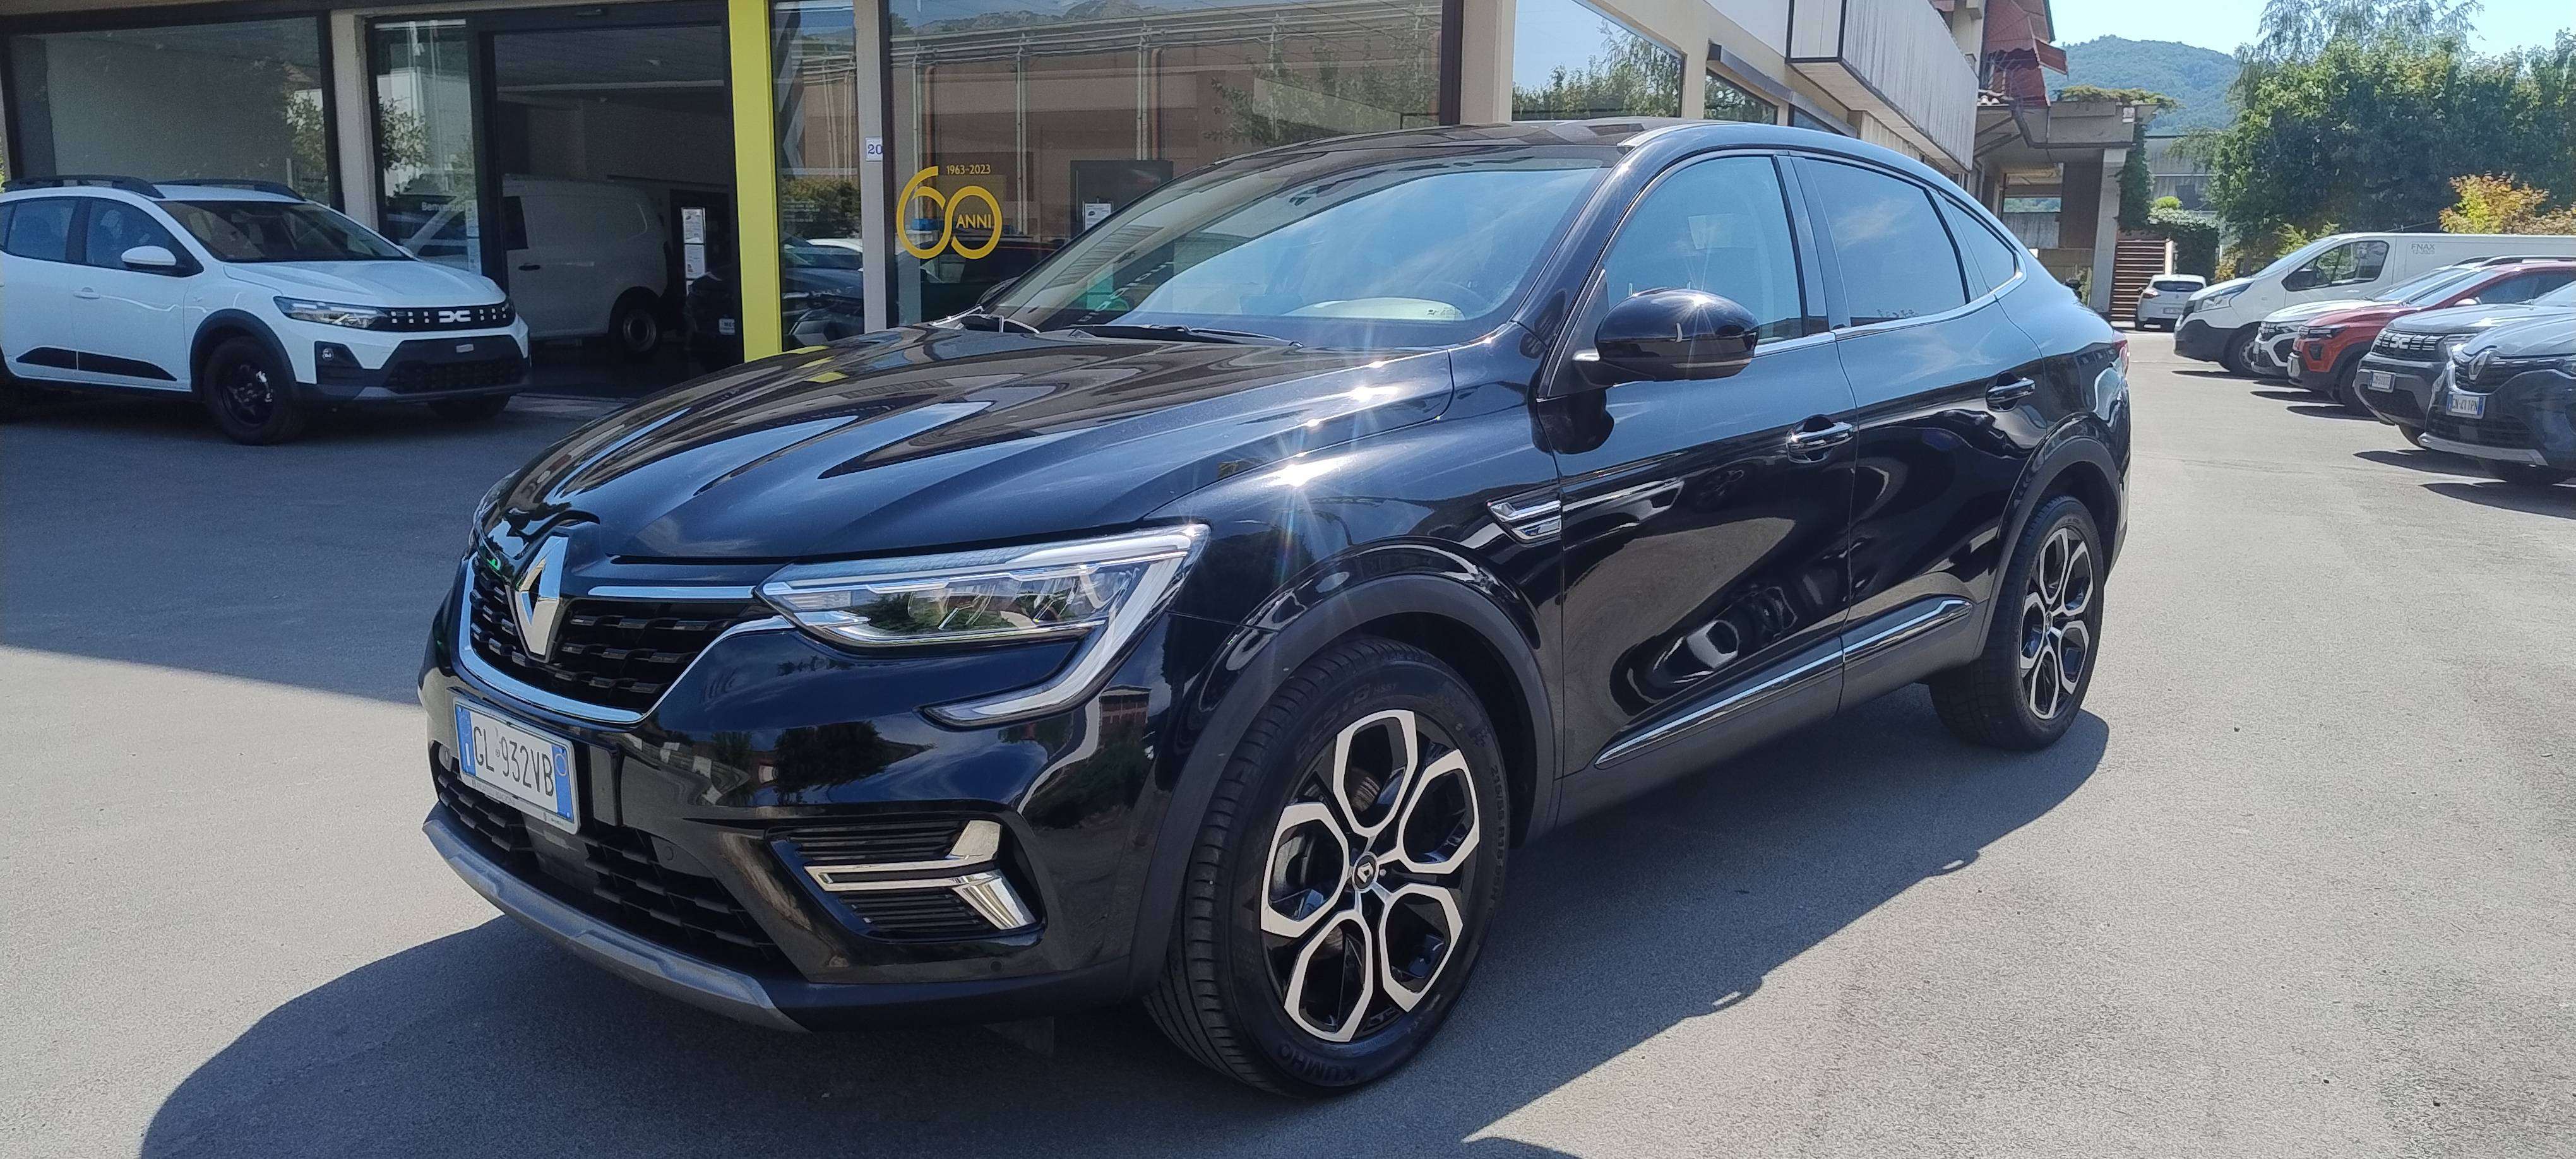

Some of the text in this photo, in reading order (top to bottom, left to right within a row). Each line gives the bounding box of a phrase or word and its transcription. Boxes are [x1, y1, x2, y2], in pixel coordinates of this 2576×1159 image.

[868, 144, 883, 155] 20
[946, 164, 991, 175] 1963-2023
[896, 165, 1003, 259] 60
[956, 214, 991, 229] ANNI
[474, 726, 494, 773] GL
[499, 736, 554, 797] 932VB
